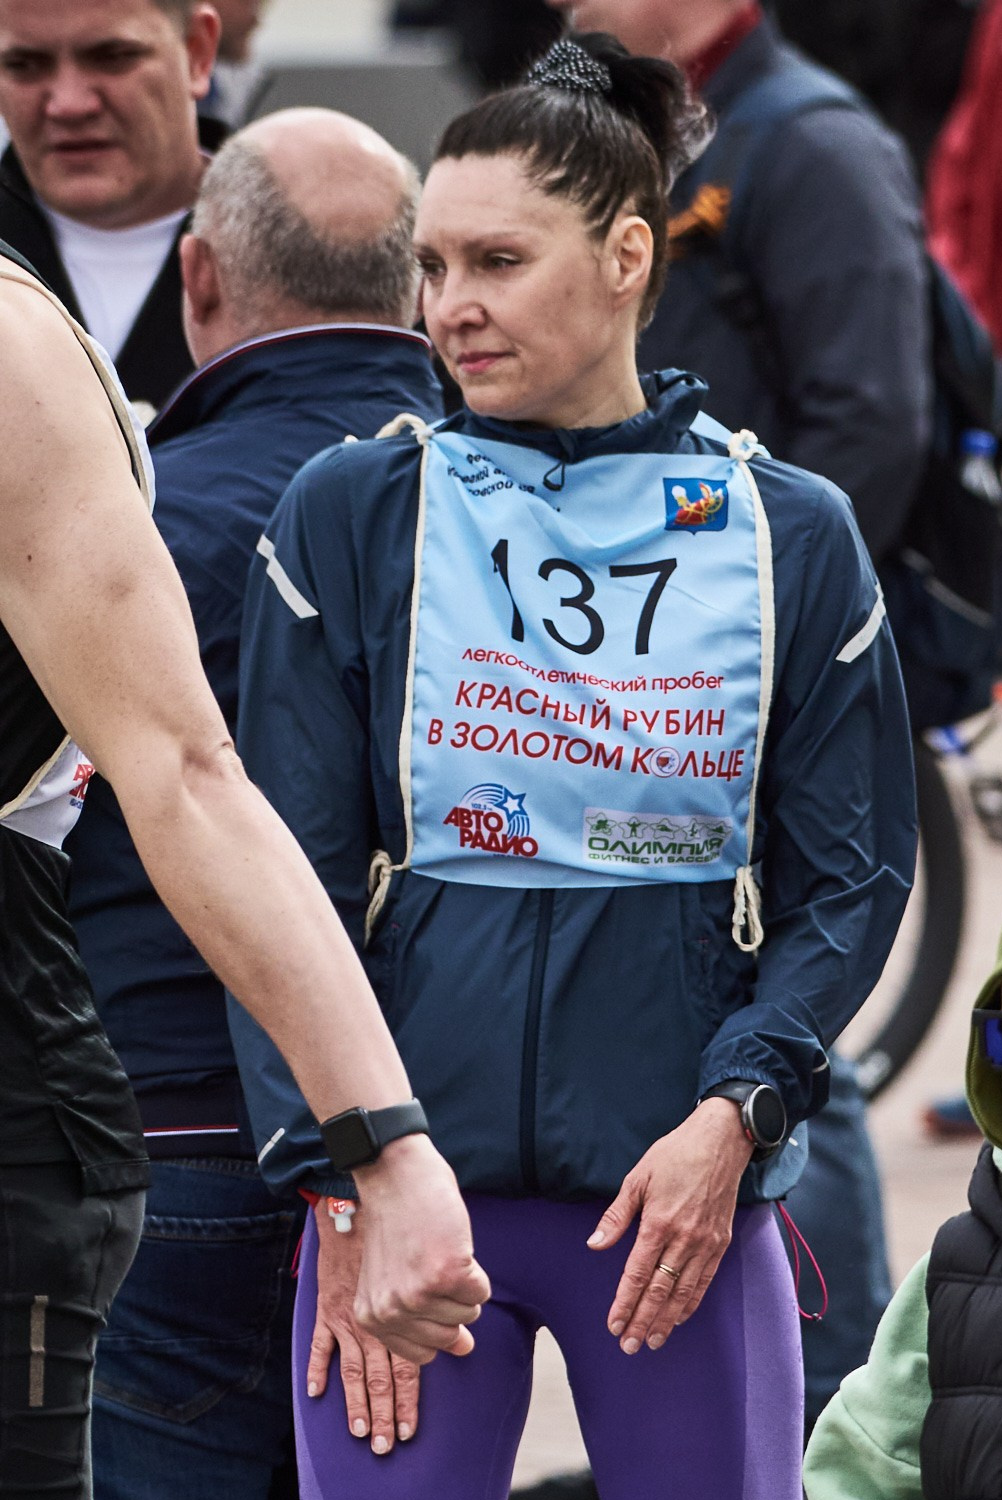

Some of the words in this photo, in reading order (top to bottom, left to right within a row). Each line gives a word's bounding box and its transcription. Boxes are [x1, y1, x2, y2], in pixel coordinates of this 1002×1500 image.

[491, 538, 677, 655] 137
[462, 648, 647, 692] легкоатлетический
[652, 671, 724, 694] пробег
[455, 680, 611, 731] КРАСНЫЙ
[622, 709, 725, 736] РУБИН
[427, 718, 443, 745] В
[450, 721, 623, 773] ЗОЛОТОМ
[443, 806, 503, 833] АВТО
[460, 827, 538, 857] РАДИО
[588, 837, 724, 855] ОЛИМПИЯ
[588, 853, 650, 864] ФИТНЕС
